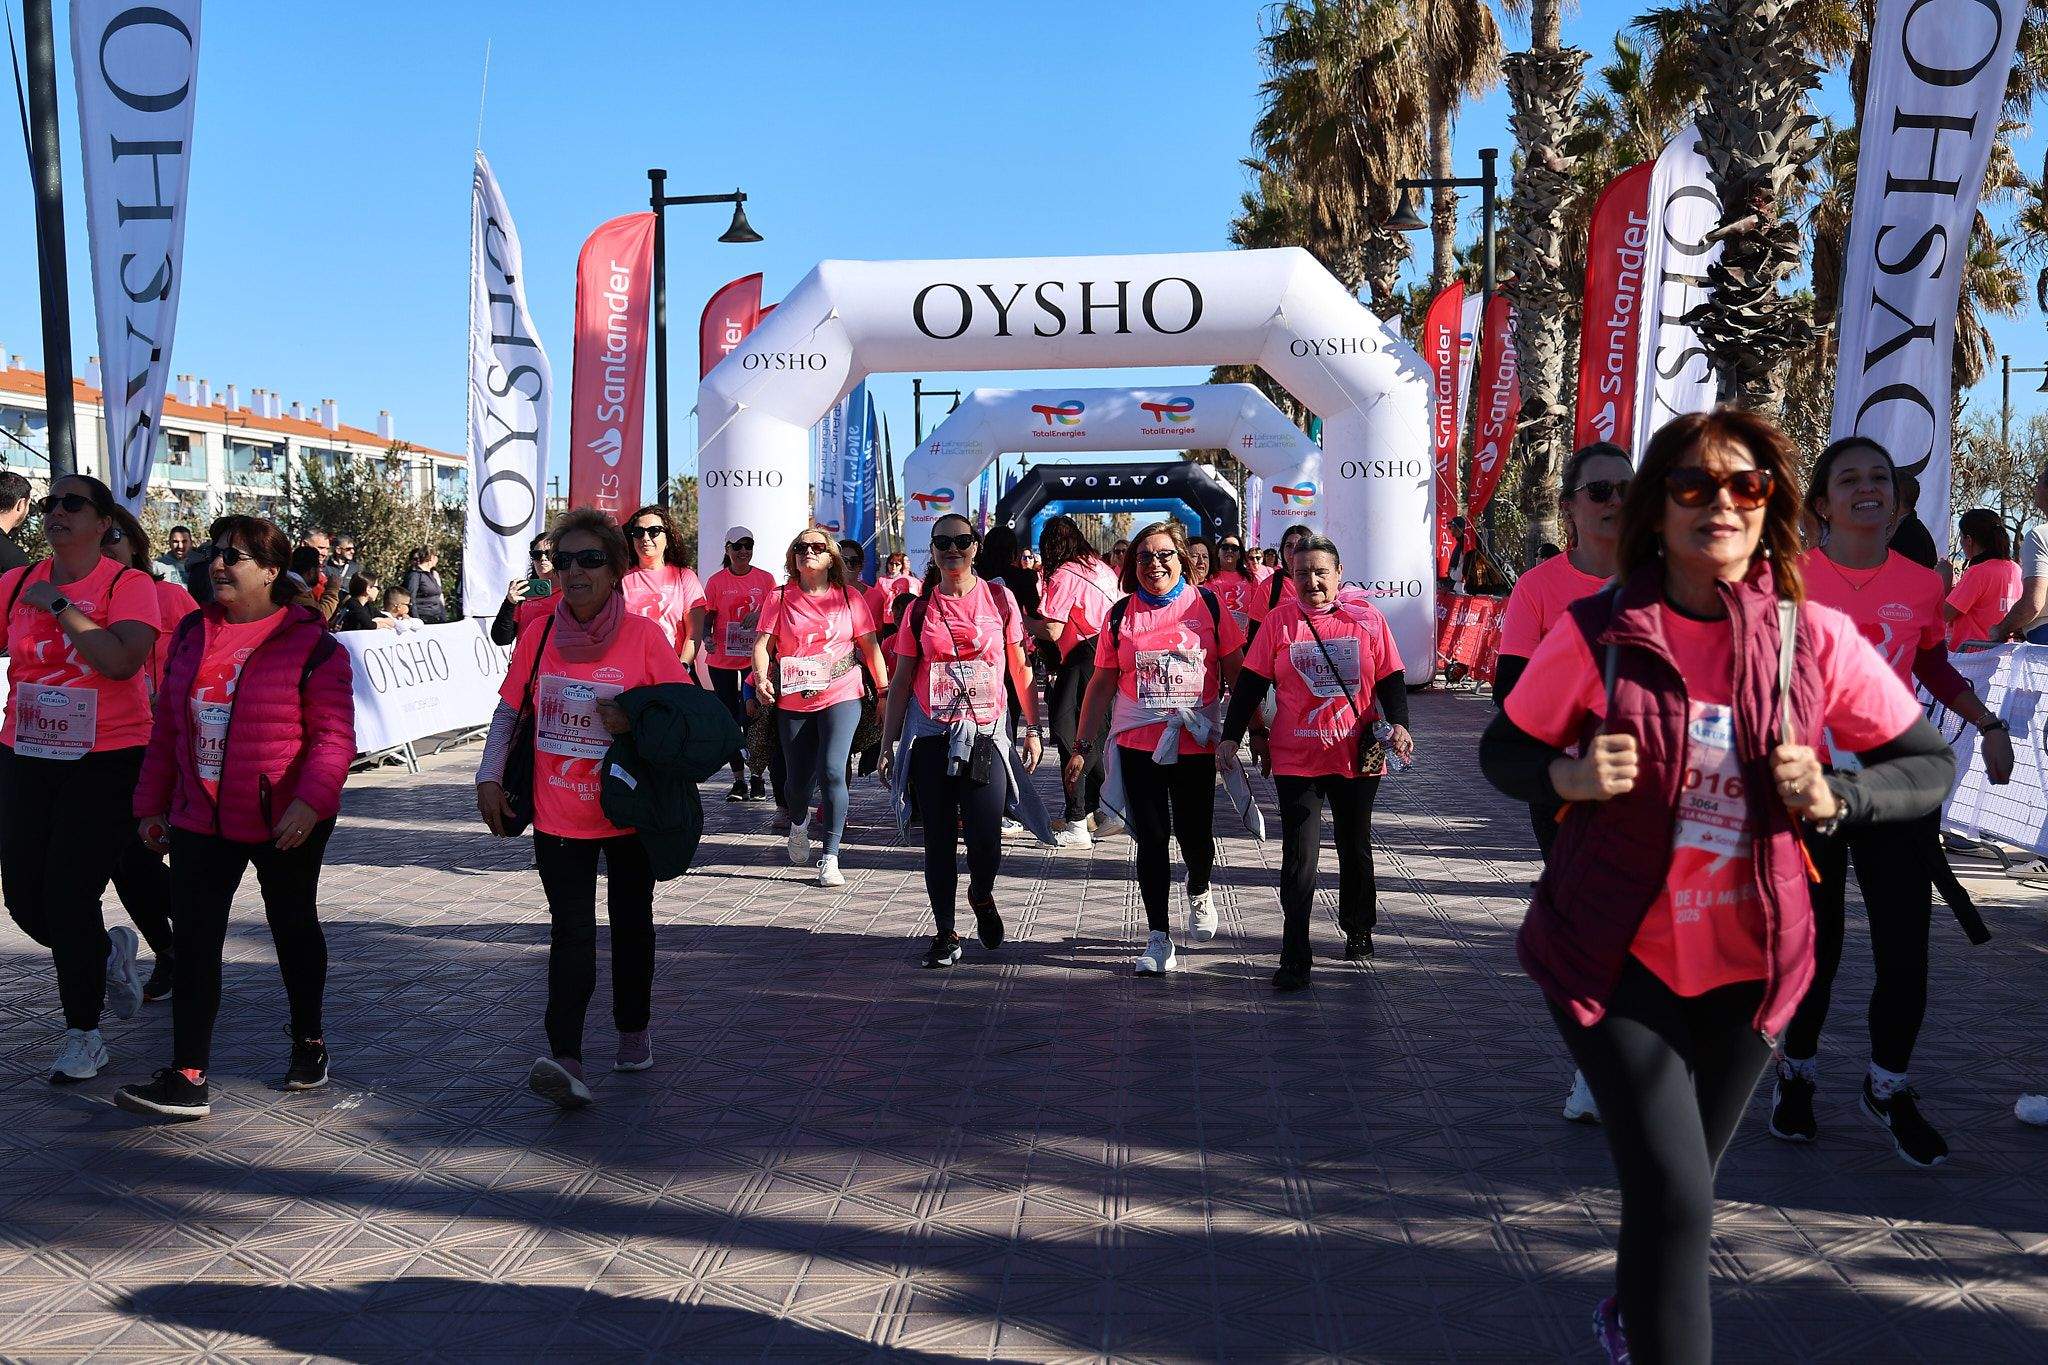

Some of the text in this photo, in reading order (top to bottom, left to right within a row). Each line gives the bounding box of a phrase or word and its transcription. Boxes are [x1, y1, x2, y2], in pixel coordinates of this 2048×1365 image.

[1855, 0, 2001, 479] OYSHO
[913, 277, 1203, 340] OYSHO
[1601, 210, 1648, 396] Santander
[597, 259, 629, 423] Santander
[1290, 337, 1377, 357] OYSHO
[743, 353, 827, 370] OYSHO
[1483, 306, 1519, 438] Santander
[1438, 325, 1451, 449] Santander
[1031, 430, 1086, 438] TotalEnergies
[1141, 427, 1195, 435] TotalEnergies
[1341, 460, 1421, 479] OYSHO
[706, 470, 783, 488] OYSHO
[1060, 475, 1168, 487] VOLVO
[363, 639, 449, 693] OYSHO
[798, 669, 816, 677] 016
[1159, 675, 1183, 685] 016
[953, 688, 976, 697] 06
[38, 718, 69, 731] 016
[561, 712, 591, 728] 016
[578, 783, 589, 792] DE
[1685, 768, 1743, 799] 016
[1691, 797, 1719, 811] 3064
[1675, 889, 1692, 906] DE
[1696, 890, 1712, 907] LA
[1676, 908, 1699, 923] 2025
